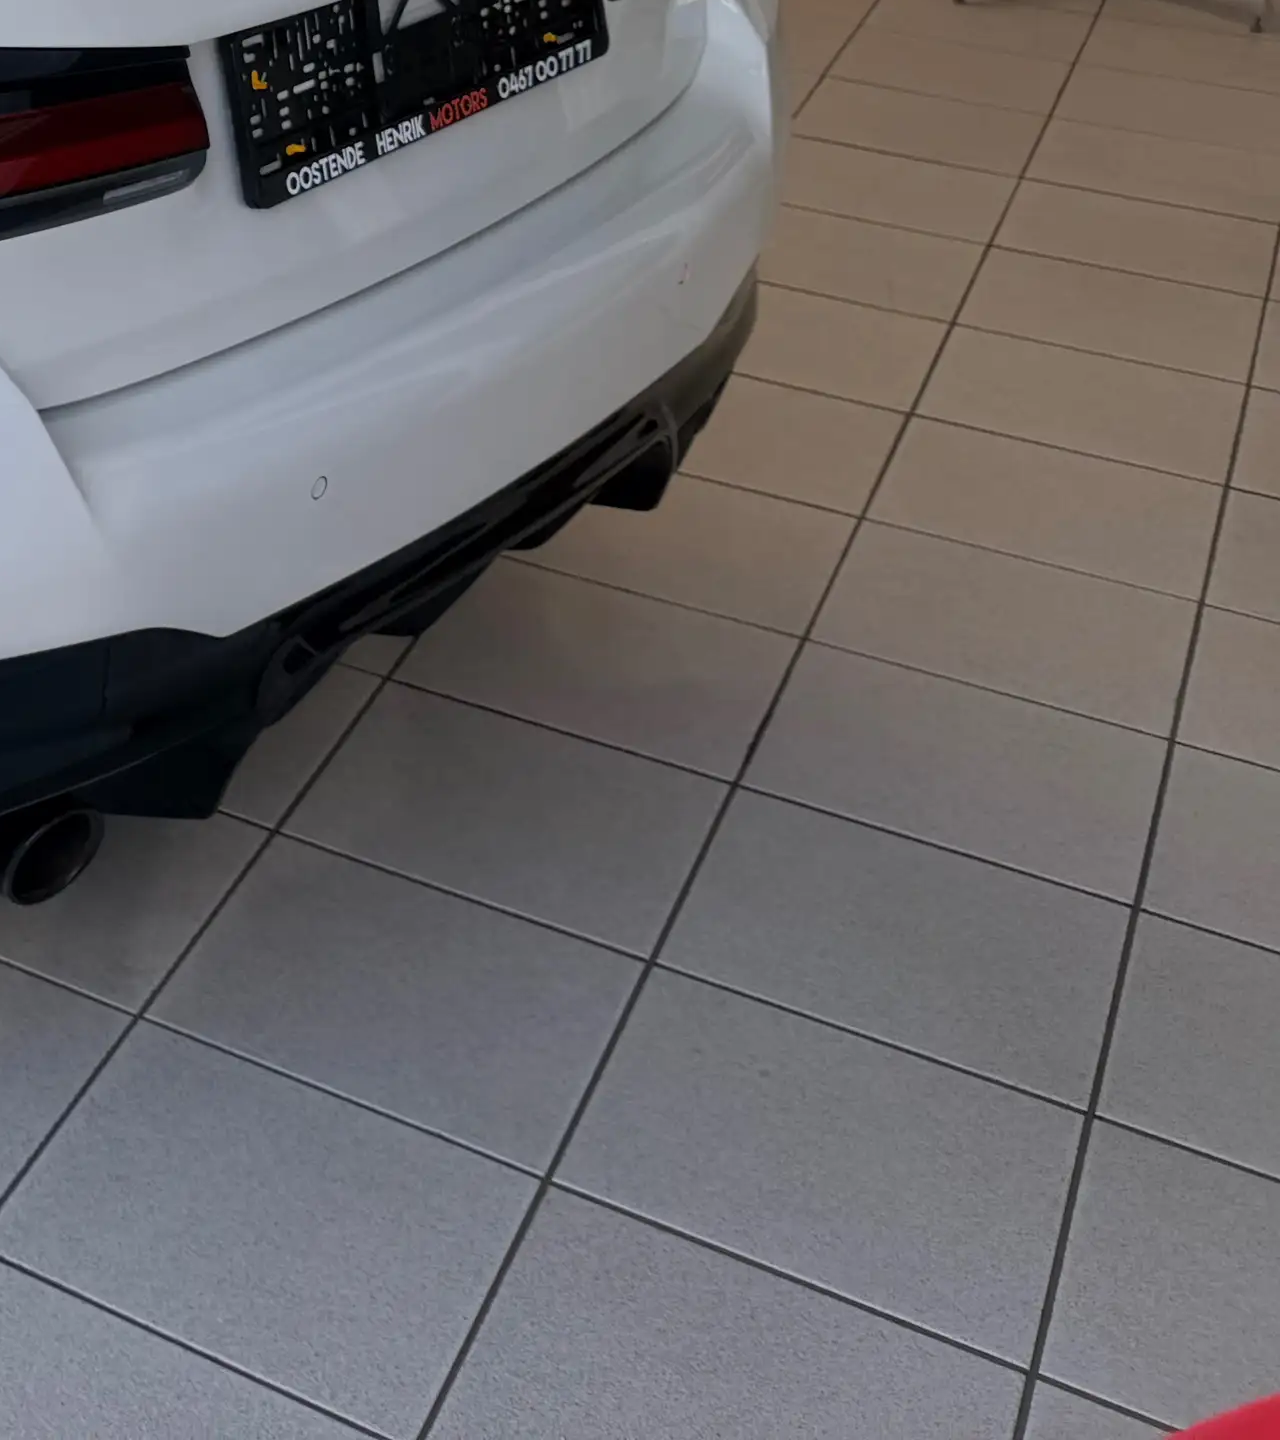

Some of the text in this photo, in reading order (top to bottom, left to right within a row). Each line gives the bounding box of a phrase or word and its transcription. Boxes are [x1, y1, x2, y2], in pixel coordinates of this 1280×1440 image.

[286, 141, 365, 195] OOSTENDE
[376, 114, 426, 155] HENRIK
[429, 88, 488, 130] MOTORS
